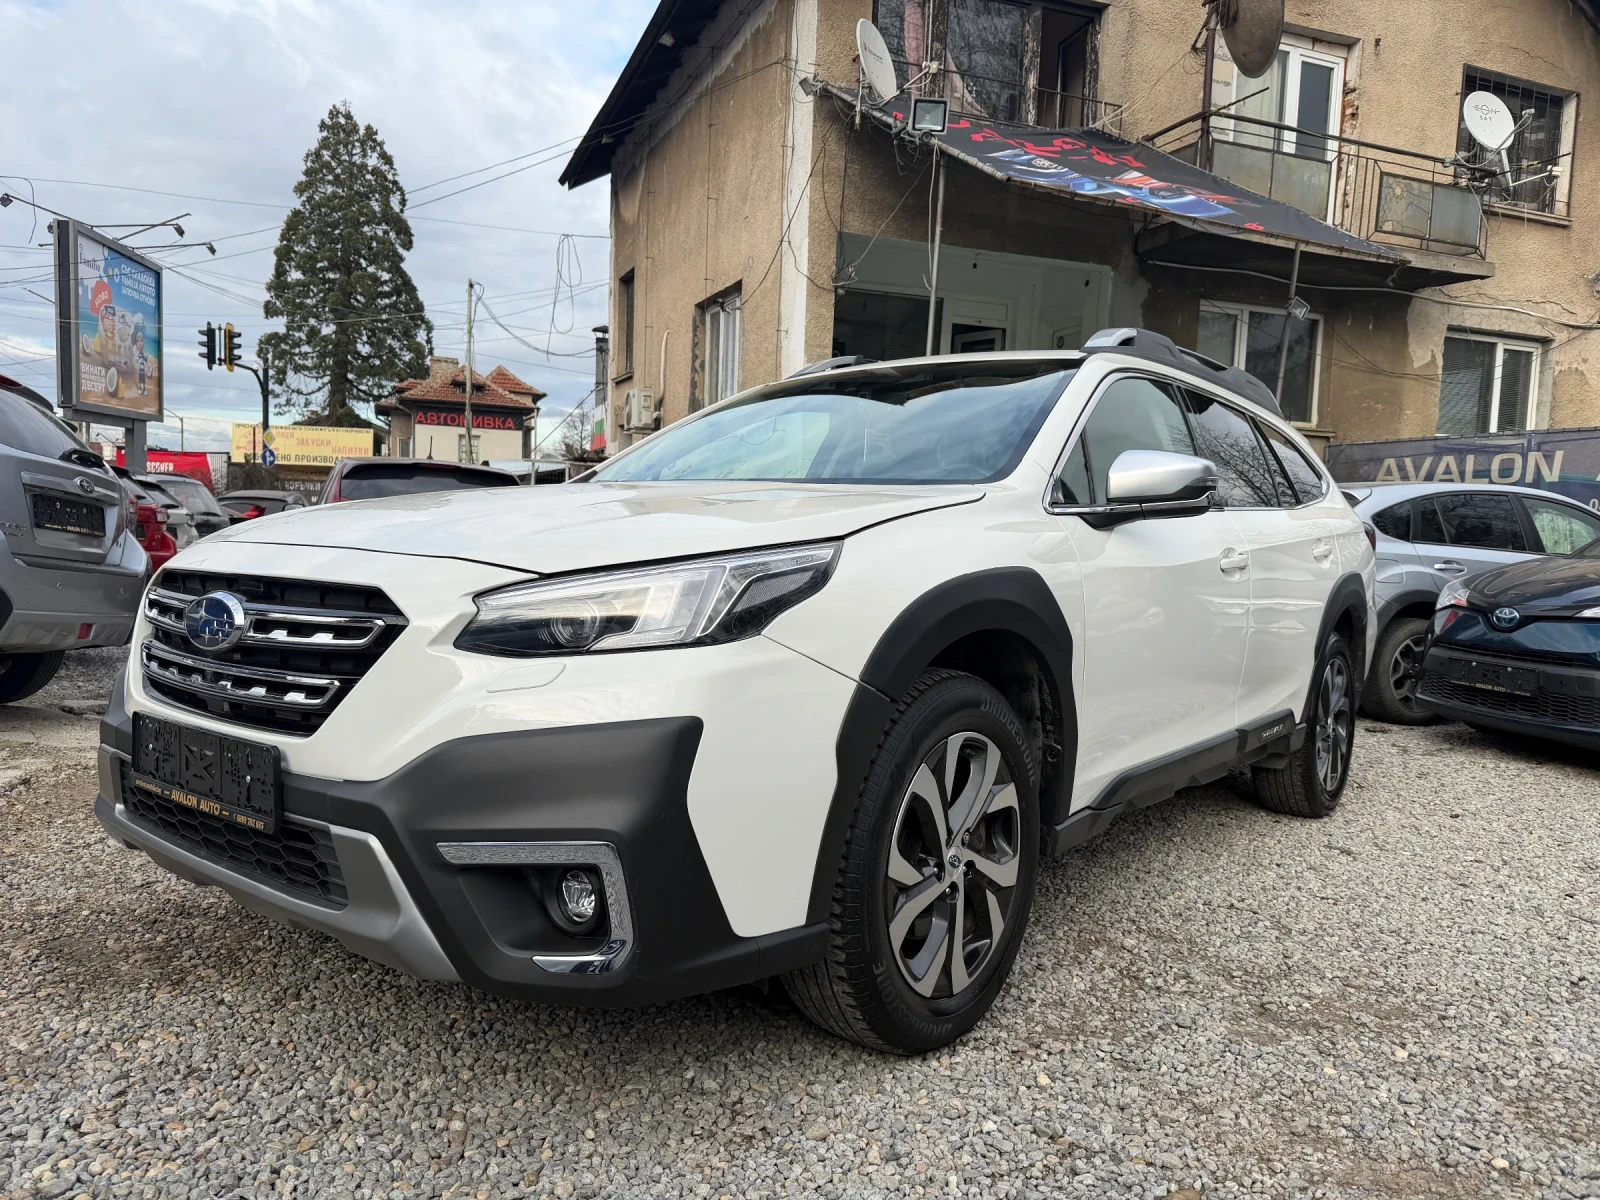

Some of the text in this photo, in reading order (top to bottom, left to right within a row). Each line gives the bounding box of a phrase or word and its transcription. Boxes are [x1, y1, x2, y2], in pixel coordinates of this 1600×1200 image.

[94, 291, 109, 308] НОВО
[81, 362, 105, 377] ВИНАГИ
[82, 380, 105, 393] ДЕСЕРТ
[276, 431, 295, 439] ПИЦИ
[296, 438, 332, 447] ЗАКУСКИ
[331, 446, 369, 455] НАПИТКИ
[1376, 450, 1564, 484] AVALON
[979, 692, 1037, 788] BRIDGESTONE
[171, 789, 198, 808] AVALON
[200, 799, 221, 816] AUTO
